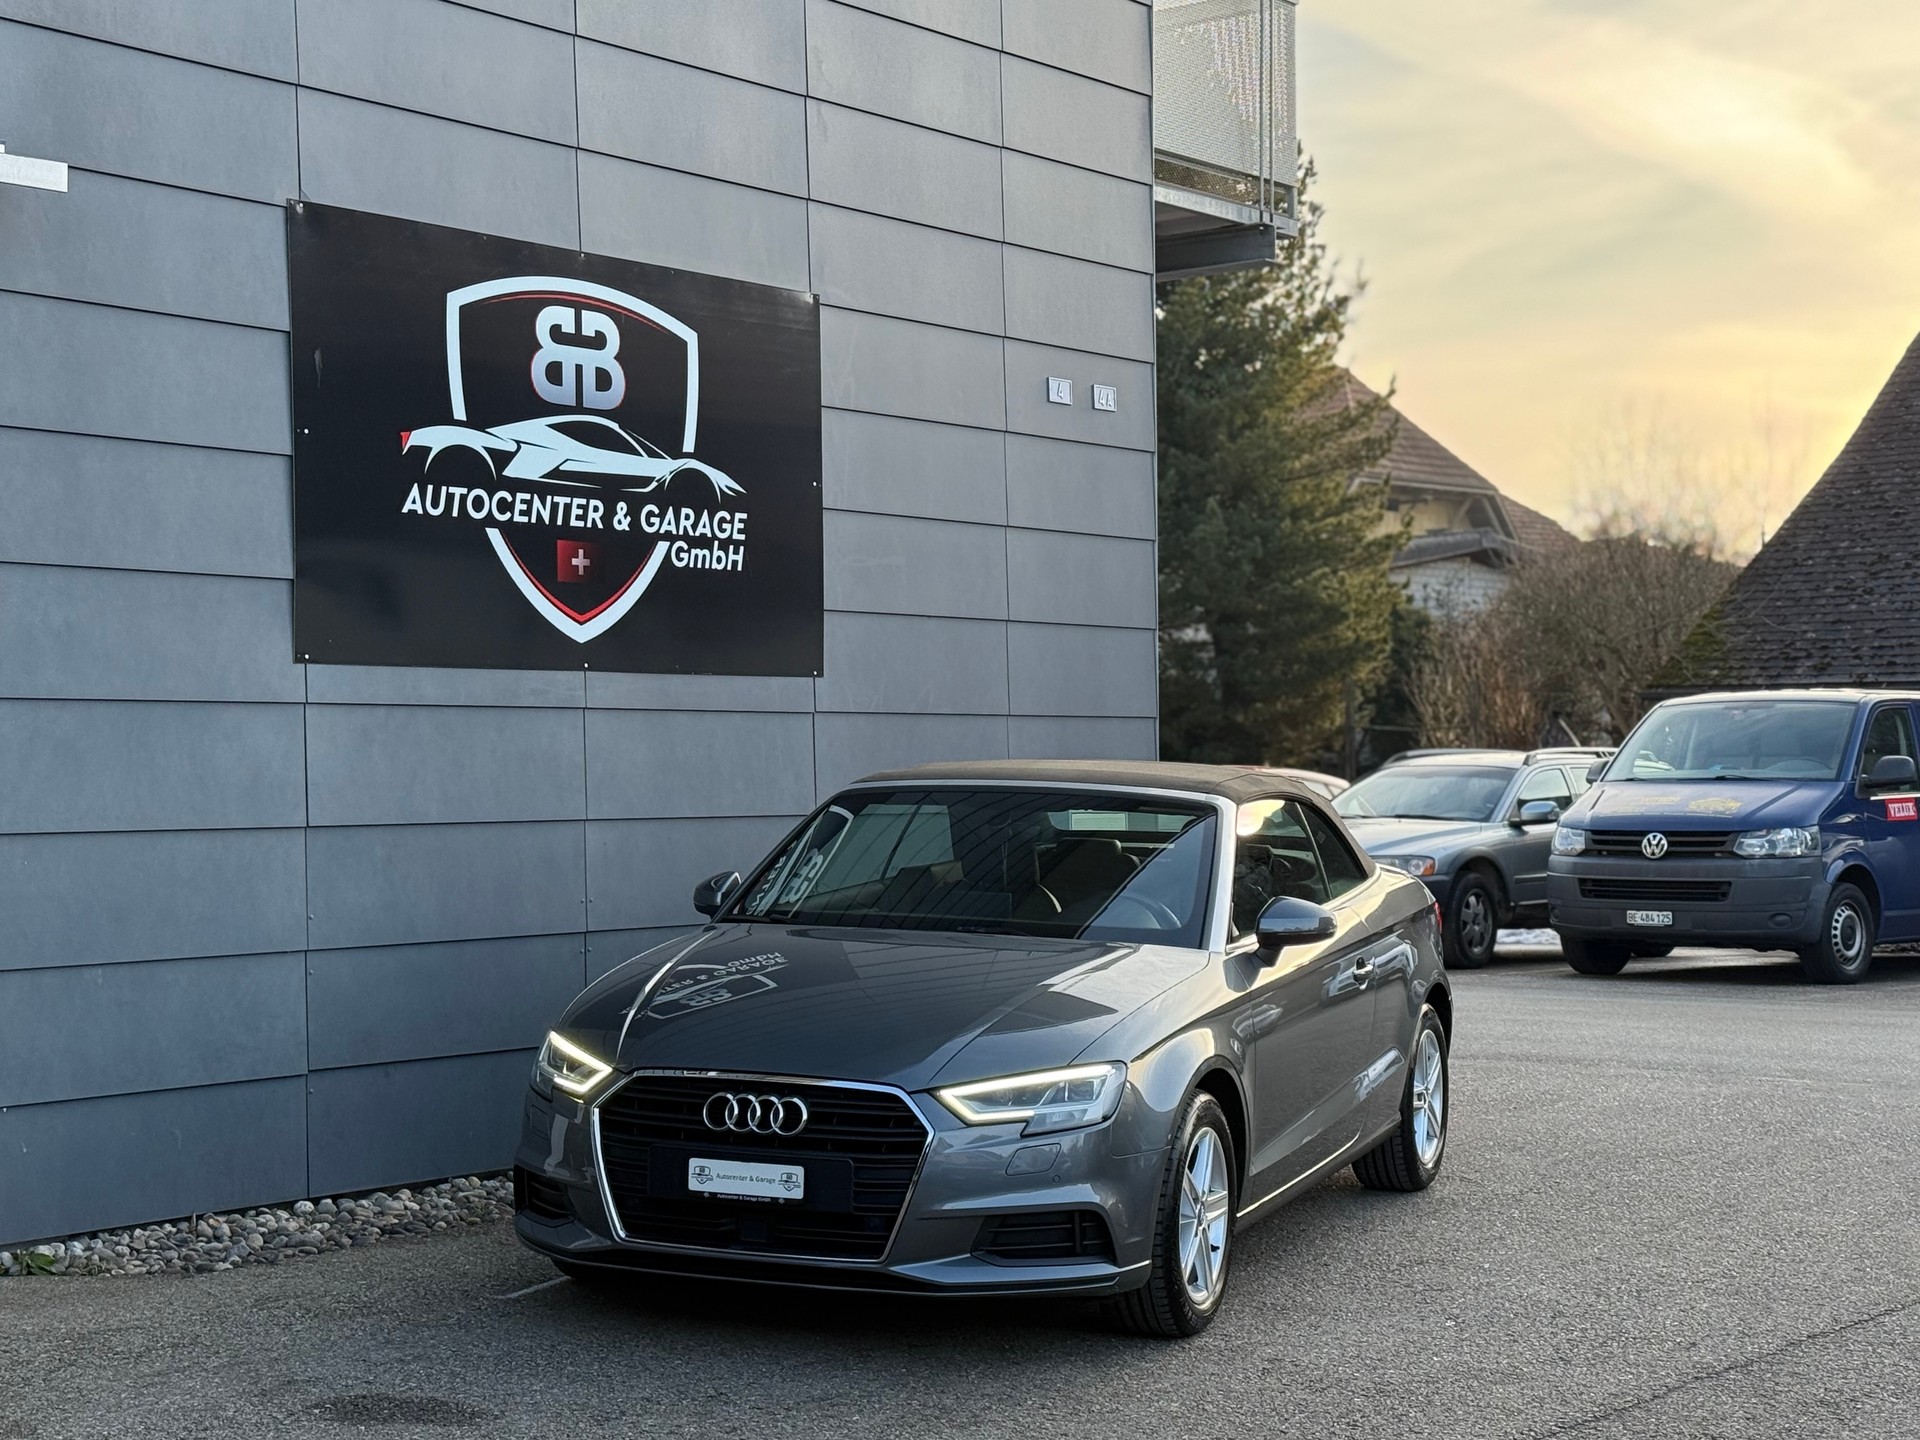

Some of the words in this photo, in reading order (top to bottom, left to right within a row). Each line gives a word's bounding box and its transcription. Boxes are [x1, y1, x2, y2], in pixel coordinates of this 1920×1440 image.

[401, 483, 604, 529] AUTOCENTER
[613, 501, 631, 531] &
[640, 504, 748, 540] GARAGE
[670, 540, 745, 571] GmbH
[1628, 912, 1639, 923] BE
[716, 1173, 747, 1181] Autocenter
[755, 1175, 776, 1184] Garage
